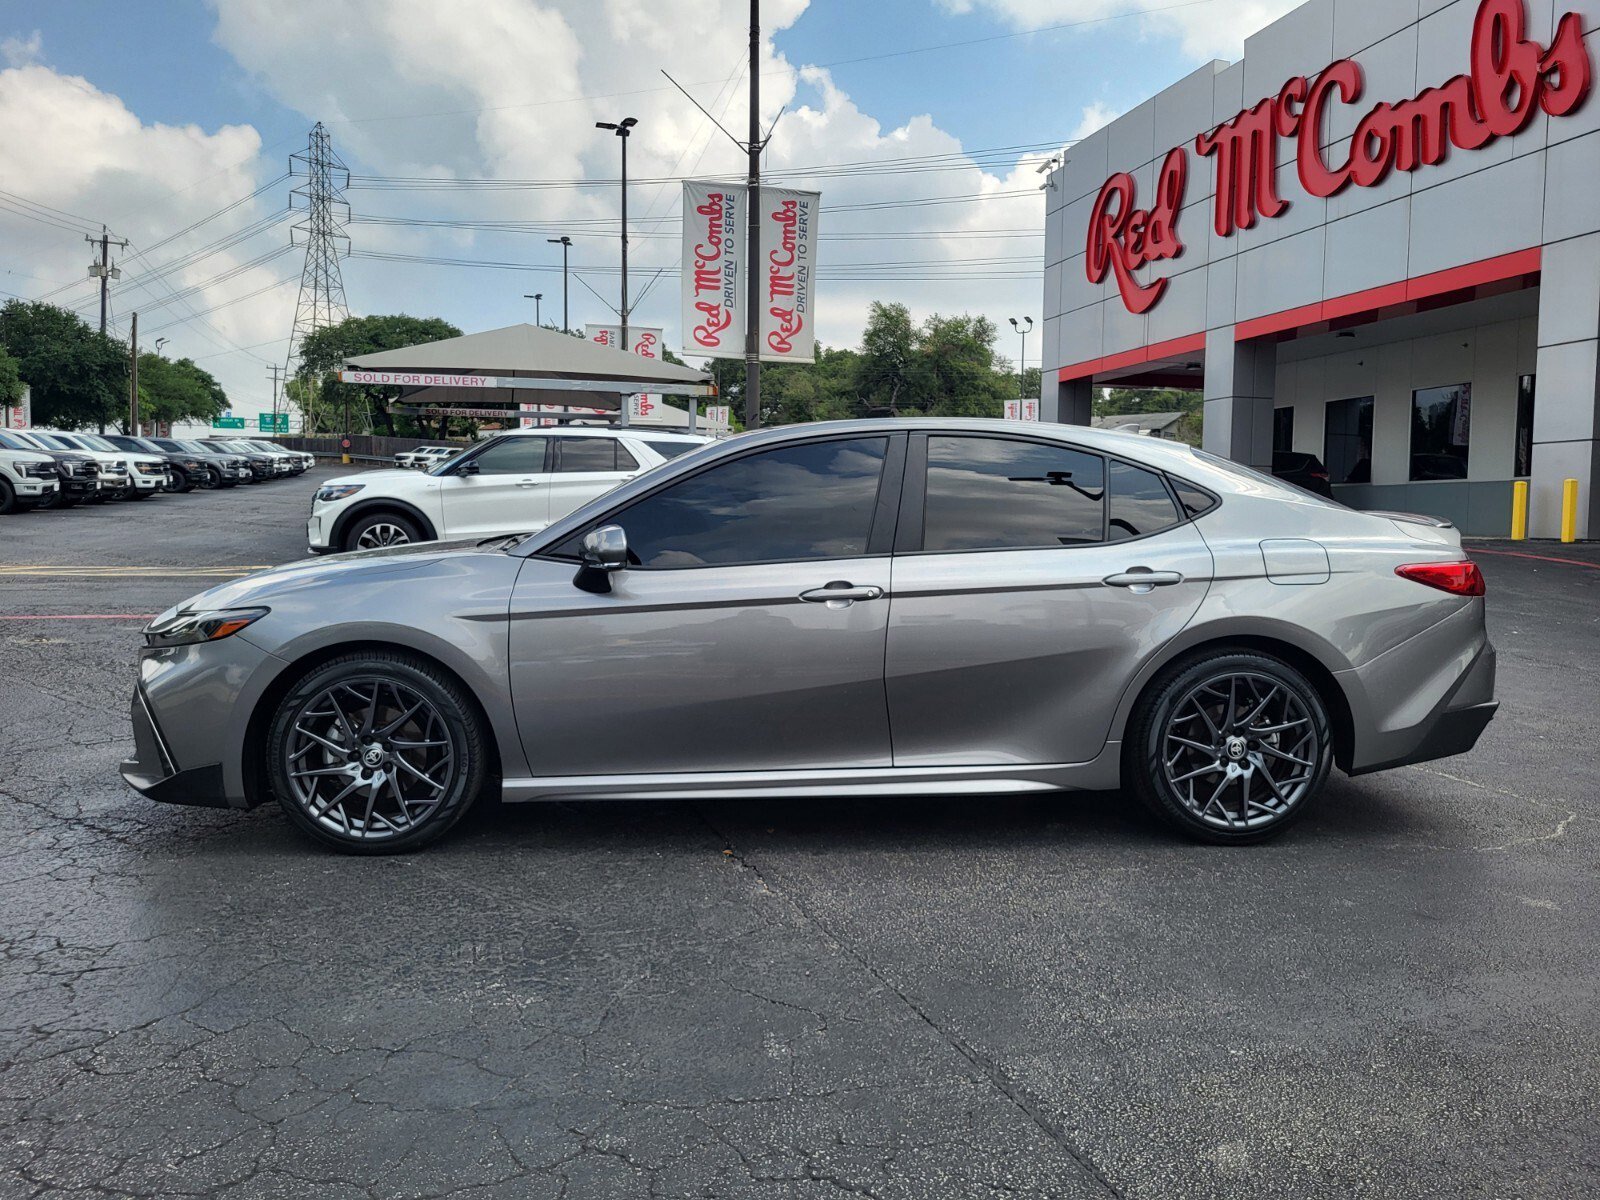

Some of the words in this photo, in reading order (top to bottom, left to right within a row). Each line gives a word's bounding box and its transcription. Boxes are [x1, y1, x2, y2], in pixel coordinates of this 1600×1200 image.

[1086, 147, 1187, 314] Red
[1195, 0, 1590, 236] McCombs
[725, 194, 735, 235] SERVE
[799, 201, 808, 240] SERVE
[694, 193, 723, 297] McCombs
[724, 238, 735, 255] TO
[769, 200, 797, 303] McCombs
[797, 245, 807, 261] TO
[724, 260, 735, 308] DRIVEN
[796, 265, 807, 313] DRIVEN
[635, 333, 656, 358] Red
[693, 301, 731, 347] Red
[768, 307, 802, 353] Red
[354, 373, 390, 383] SOLD
[394, 374, 421, 384] FOR
[424, 375, 487, 386] DELIVERY
